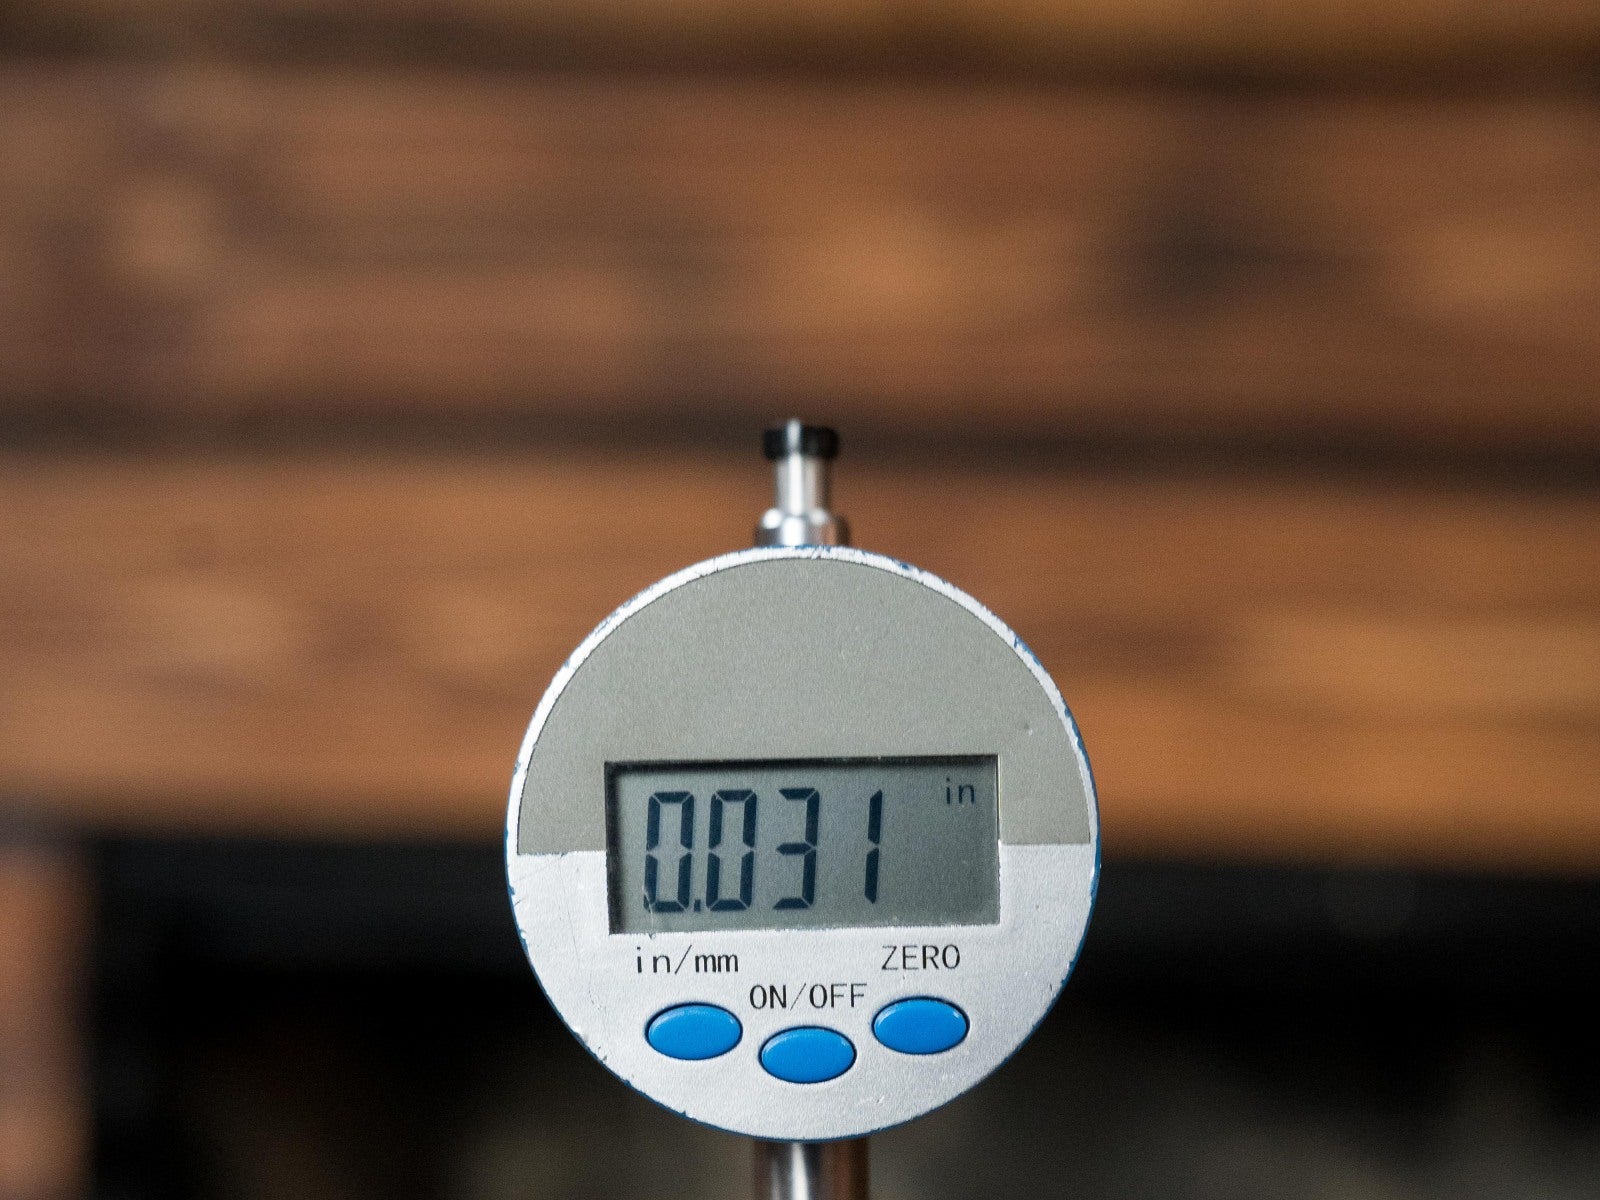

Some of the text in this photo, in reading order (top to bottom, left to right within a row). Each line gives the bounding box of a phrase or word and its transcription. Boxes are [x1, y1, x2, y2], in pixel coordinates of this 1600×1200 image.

[945, 777, 976, 805] in
[643, 788, 883, 914] 0.031
[636, 945, 739, 974] in/mm
[881, 945, 961, 971] ZERO
[749, 983, 868, 1010] ON/OFF
